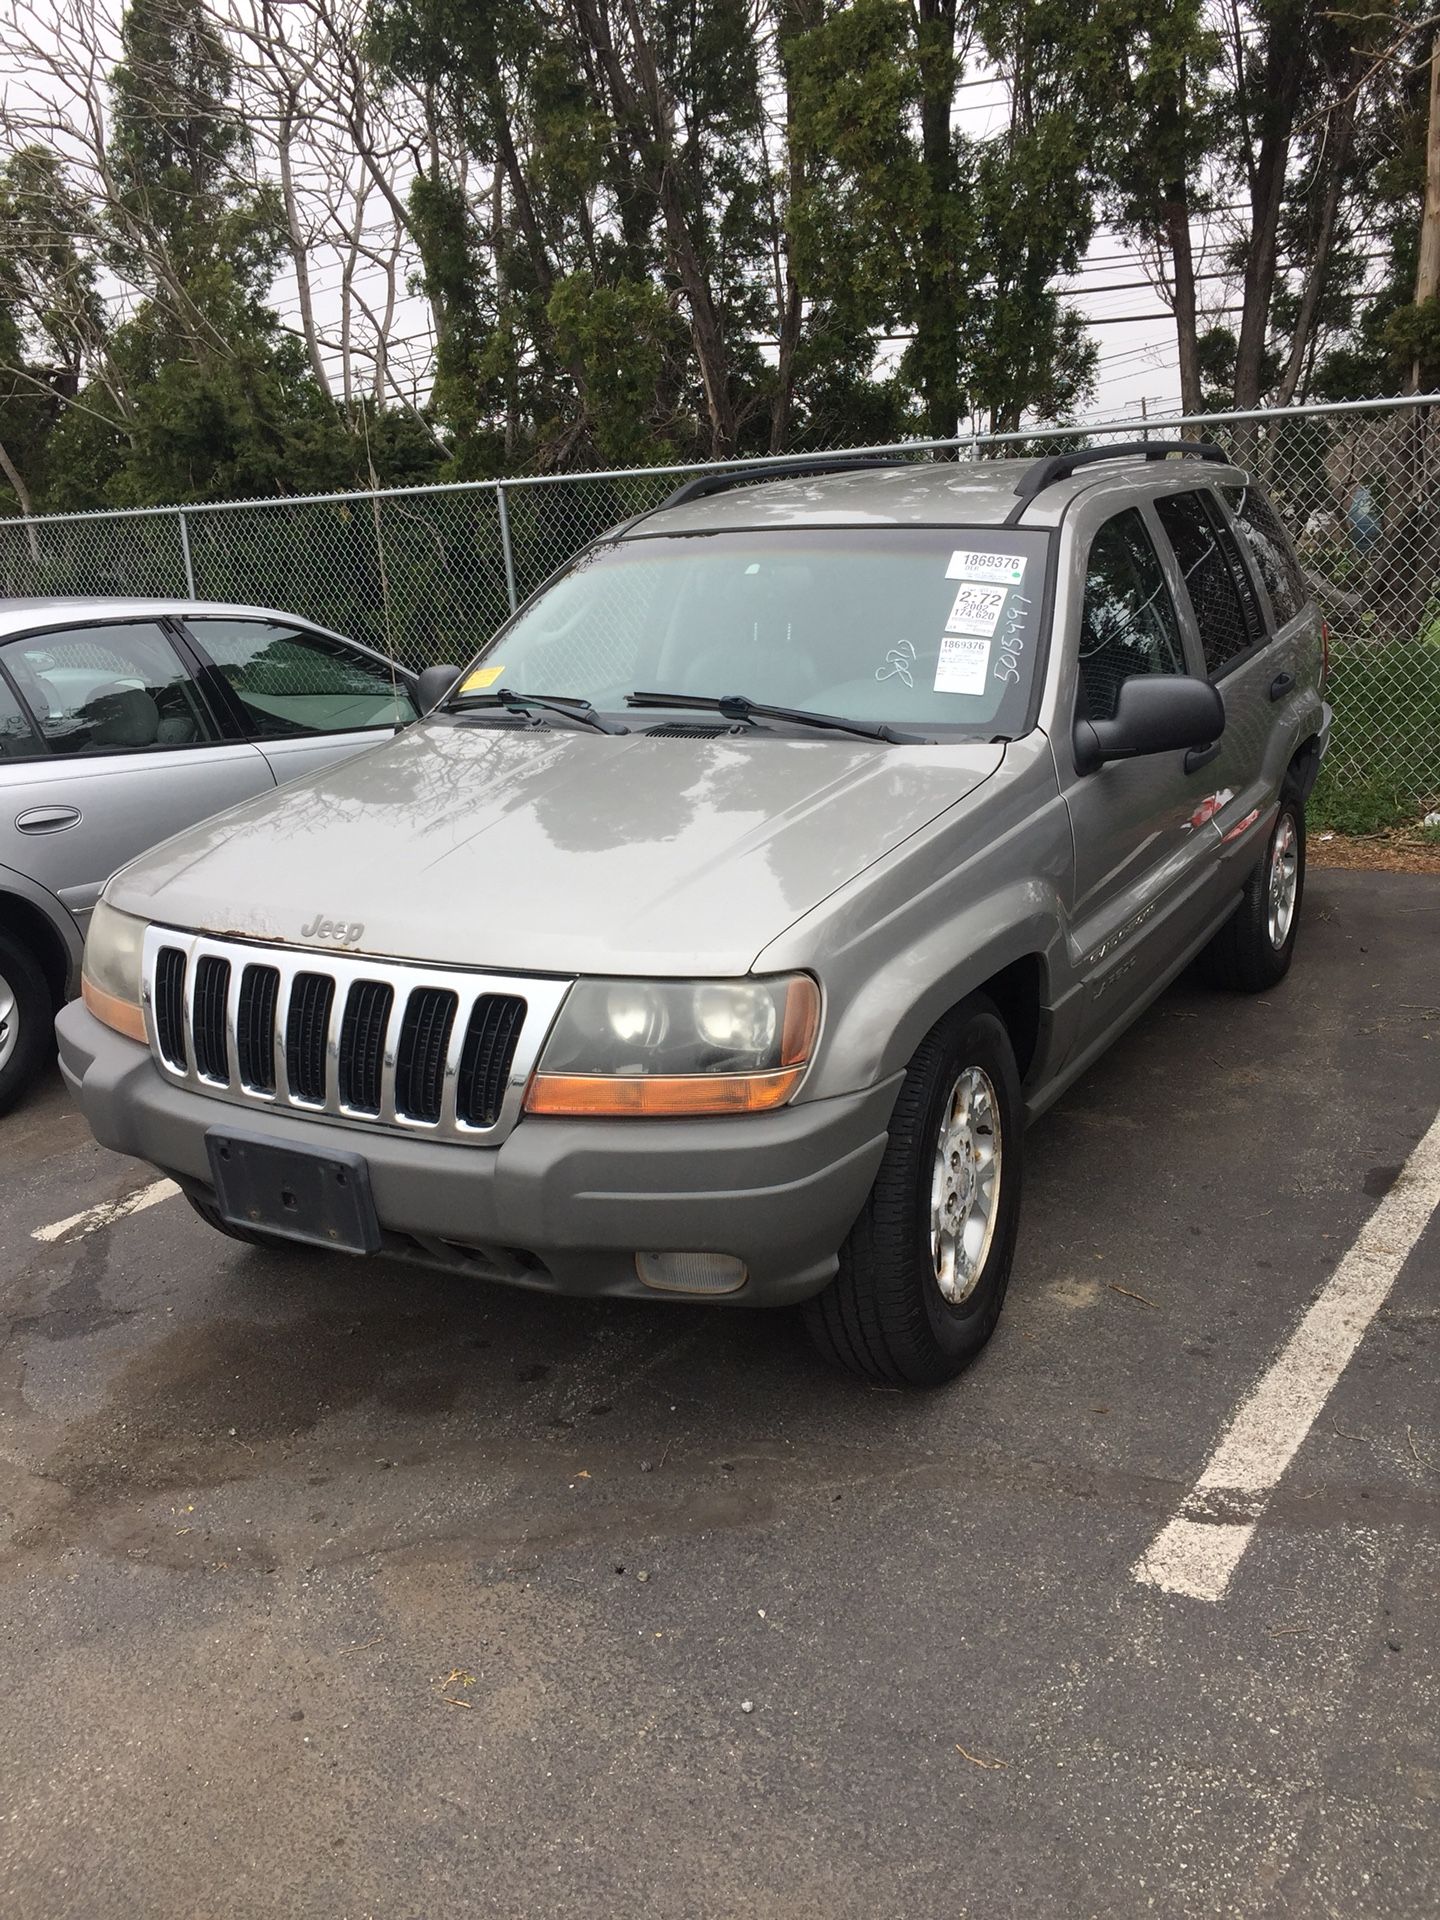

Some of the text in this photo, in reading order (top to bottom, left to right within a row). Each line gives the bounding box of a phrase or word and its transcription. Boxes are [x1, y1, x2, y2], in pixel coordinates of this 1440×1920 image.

[964, 554, 1020, 570] 1869376
[963, 602, 989, 612] 2002
[954, 608, 995, 620] 174,620
[944, 640, 985, 650] 1869376
[300, 914, 365, 946] Jeep
